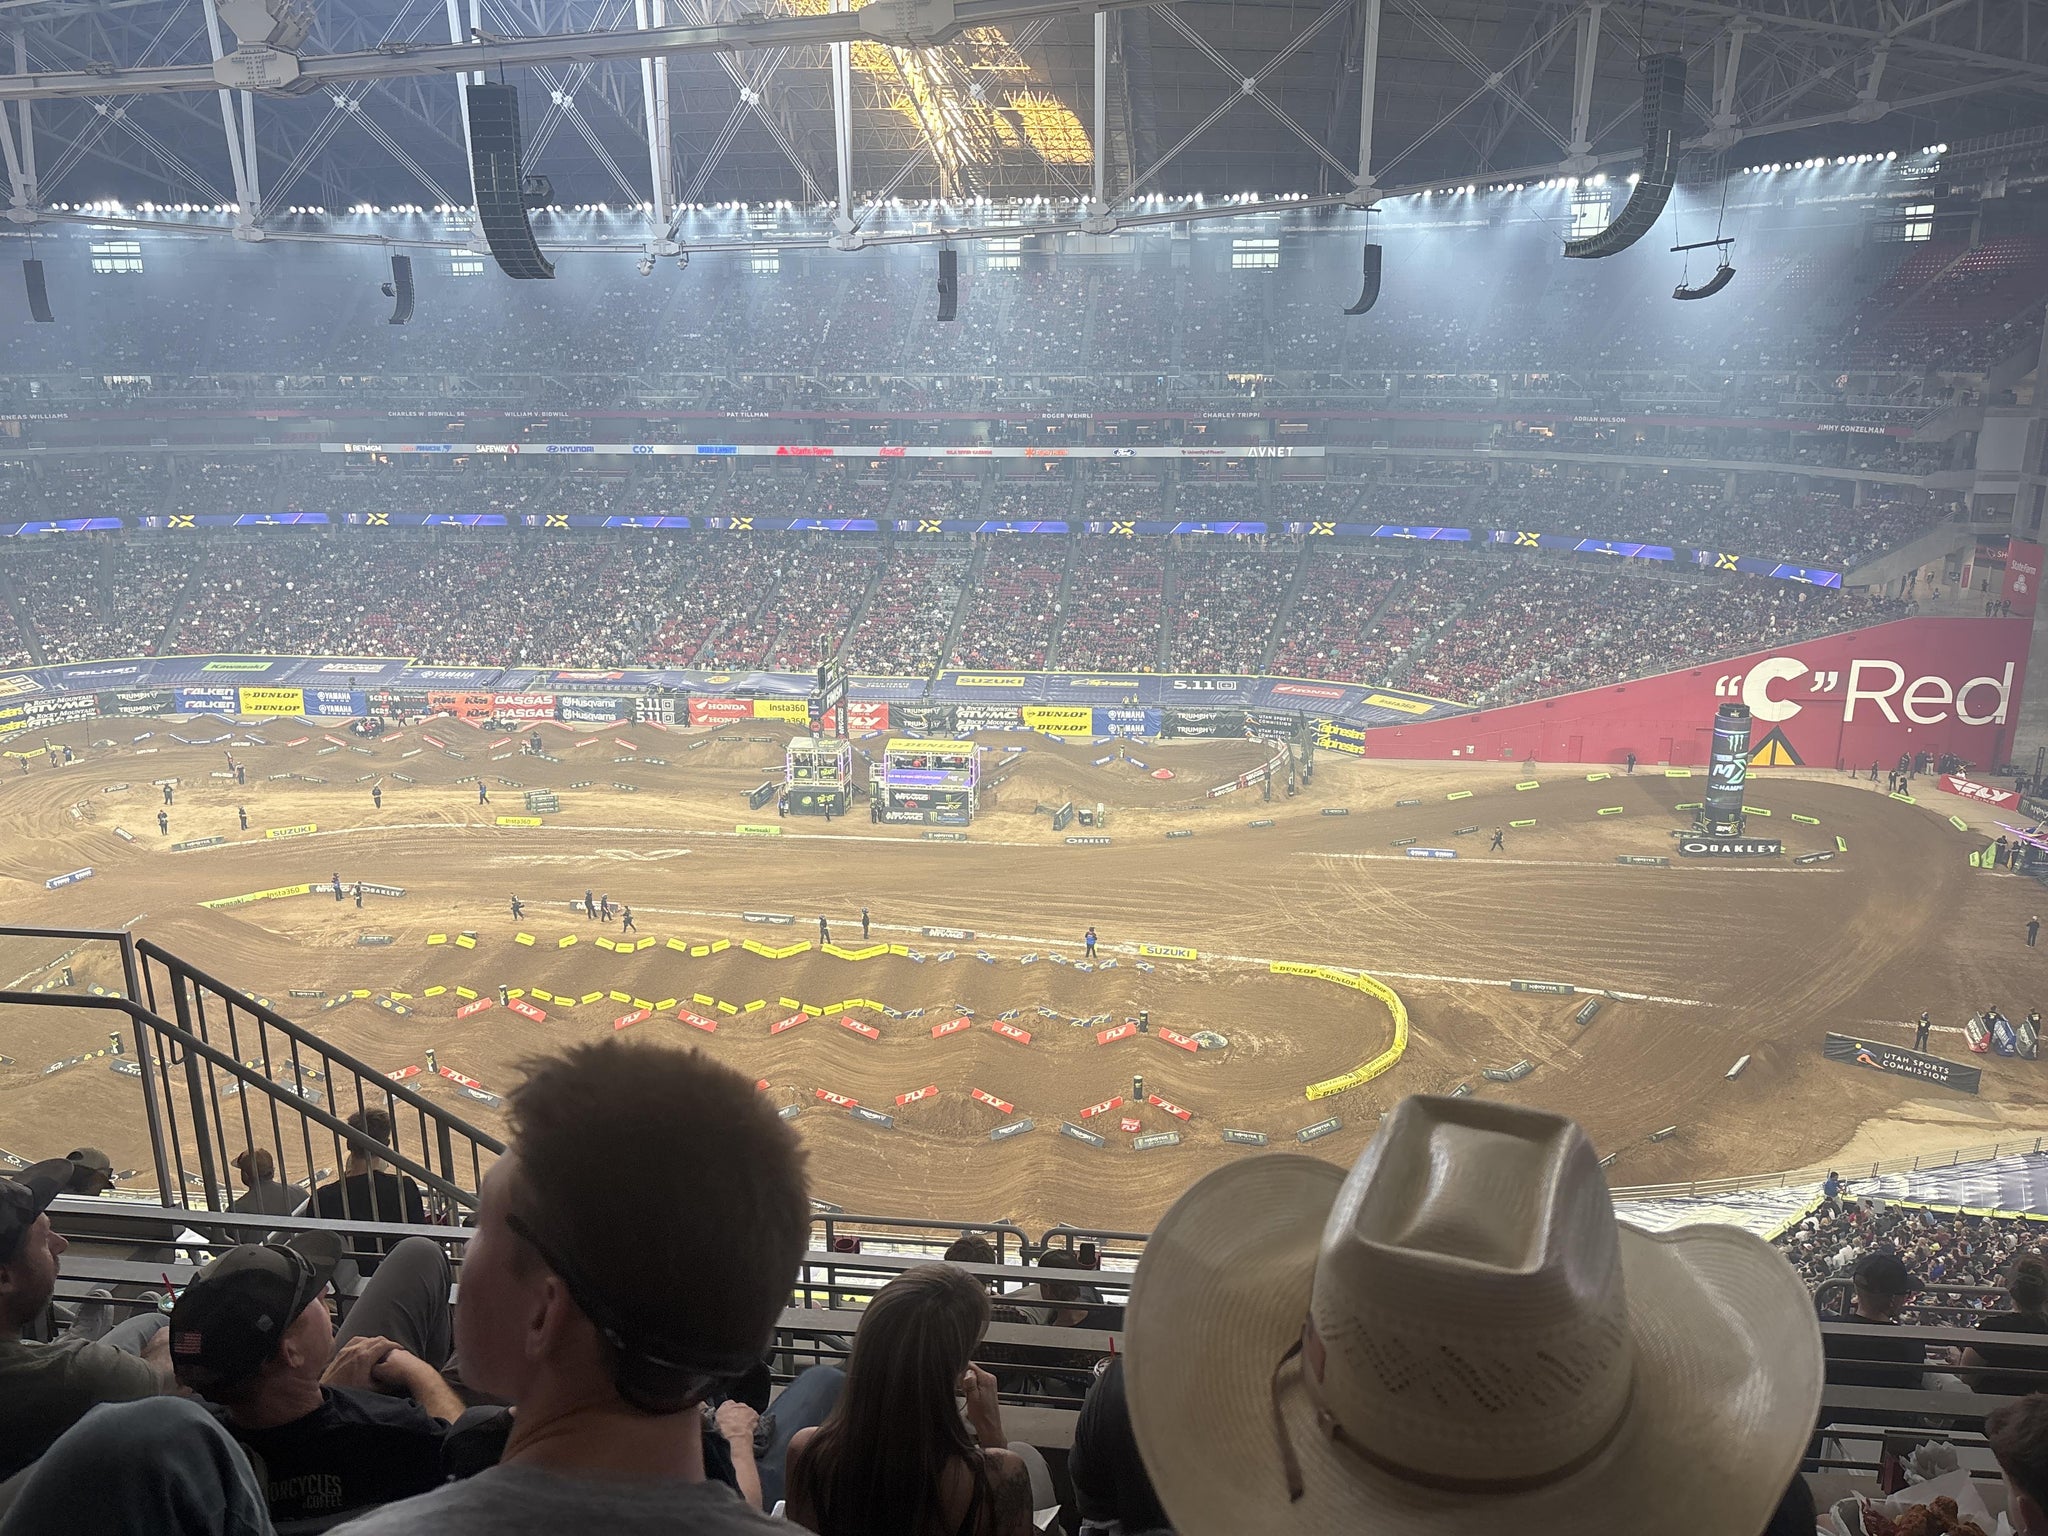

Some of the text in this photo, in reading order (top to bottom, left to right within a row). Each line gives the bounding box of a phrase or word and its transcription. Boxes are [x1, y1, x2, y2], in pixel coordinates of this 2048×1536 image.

[0, 413, 69, 421] ENEAS WILLIAMS
[1817, 424, 1885, 434] JIMMY CONZELMAN
[352, 444, 382, 452] BETMGM
[475, 445, 509, 453] SAFEWAY
[632, 446, 655, 454] COX
[1248, 447, 1294, 457] AVNET
[1173, 680, 1215, 690] 5.11
[117, 693, 150, 701] TRIUMPH
[183, 688, 234, 696] FALKEN
[325, 692, 351, 700] YAMAHA
[1291, 687, 1340, 696] HONDA
[1843, 659, 2015, 725] Red
[33, 694, 94, 706] ROCKY MOUNTAIN
[185, 701, 235, 709] FALKEN
[494, 696, 553, 705] GASGAS
[571, 698, 616, 708] Husqvarna
[635, 698, 661, 711] 5.11
[119, 705, 151, 713] TRIUMPH
[326, 705, 353, 713] YAMAHA
[467, 709, 490, 717] KTM
[708, 703, 747, 711] HONDA
[769, 703, 805, 711] Insta360
[36, 707, 97, 720] ROCKY MOUNTAIN
[572, 710, 616, 721] Husqvarna
[636, 712, 661, 723] 5.11
[1116, 711, 1145, 719] YAMAHA
[1116, 725, 1145, 733] YMAHA
[1258, 720, 1292, 728] COMMISSION
[1321, 722, 1366, 740] alpinestars
[1321, 736, 1365, 755] alpinestars
[1948, 776, 2013, 802] FLY
[272, 826, 312, 837] SUZUKI
[1709, 845, 1778, 853] OAKLEY
[266, 887, 300, 899] Insta360
[209, 898, 244, 909] Kawasaki
[1146, 946, 1191, 958] SUZUKI
[1279, 966, 1317, 975] DUNLOP
[1325, 973, 1356, 987] DUNLOP
[464, 1000, 482, 1014] FLY
[516, 1003, 537, 1016] FLY
[621, 1012, 641, 1025] FLY
[686, 1014, 709, 1026] FLY
[779, 1015, 799, 1029] FLY
[849, 1020, 872, 1033] FLY
[940, 1020, 960, 1034] FLY
[1000, 1024, 1022, 1037] FLY
[1106, 1026, 1127, 1040] FLY
[1168, 1032, 1190, 1045] FLY
[1884, 1052, 1950, 1075] UTAH SPORTS
[447, 1070, 470, 1084] FLY
[1882, 1060, 1949, 1082] COMMISSION
[1323, 1079, 1362, 1097] DUNLOP
[824, 1091, 847, 1105] FLY
[904, 1088, 926, 1104] FLY
[980, 1092, 1006, 1107] FLY
[1090, 1101, 1112, 1116] FLY
[1158, 1101, 1183, 1115] FLY
